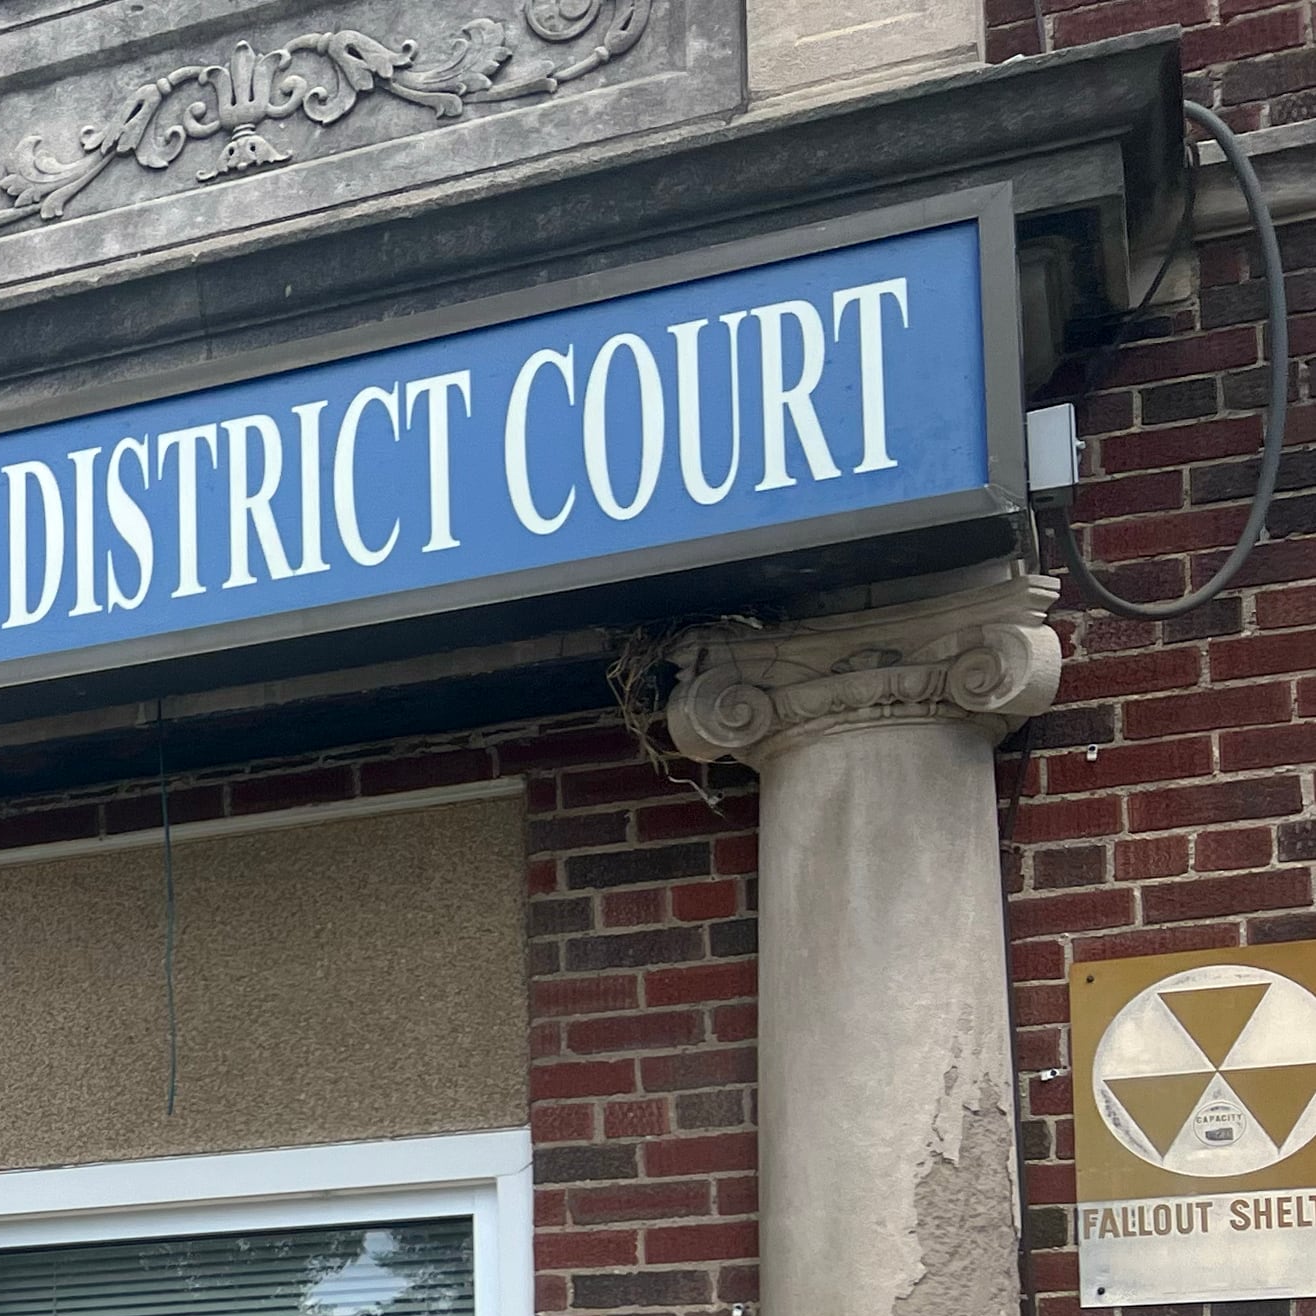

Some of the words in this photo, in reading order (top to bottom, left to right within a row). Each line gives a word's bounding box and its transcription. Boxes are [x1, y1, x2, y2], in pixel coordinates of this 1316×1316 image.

[2, 370, 470, 628] DISTRICT
[505, 278, 907, 534] COURT
[1196, 1114, 1243, 1124] CAPACITY
[1083, 1202, 1213, 1240] FALLOUT
